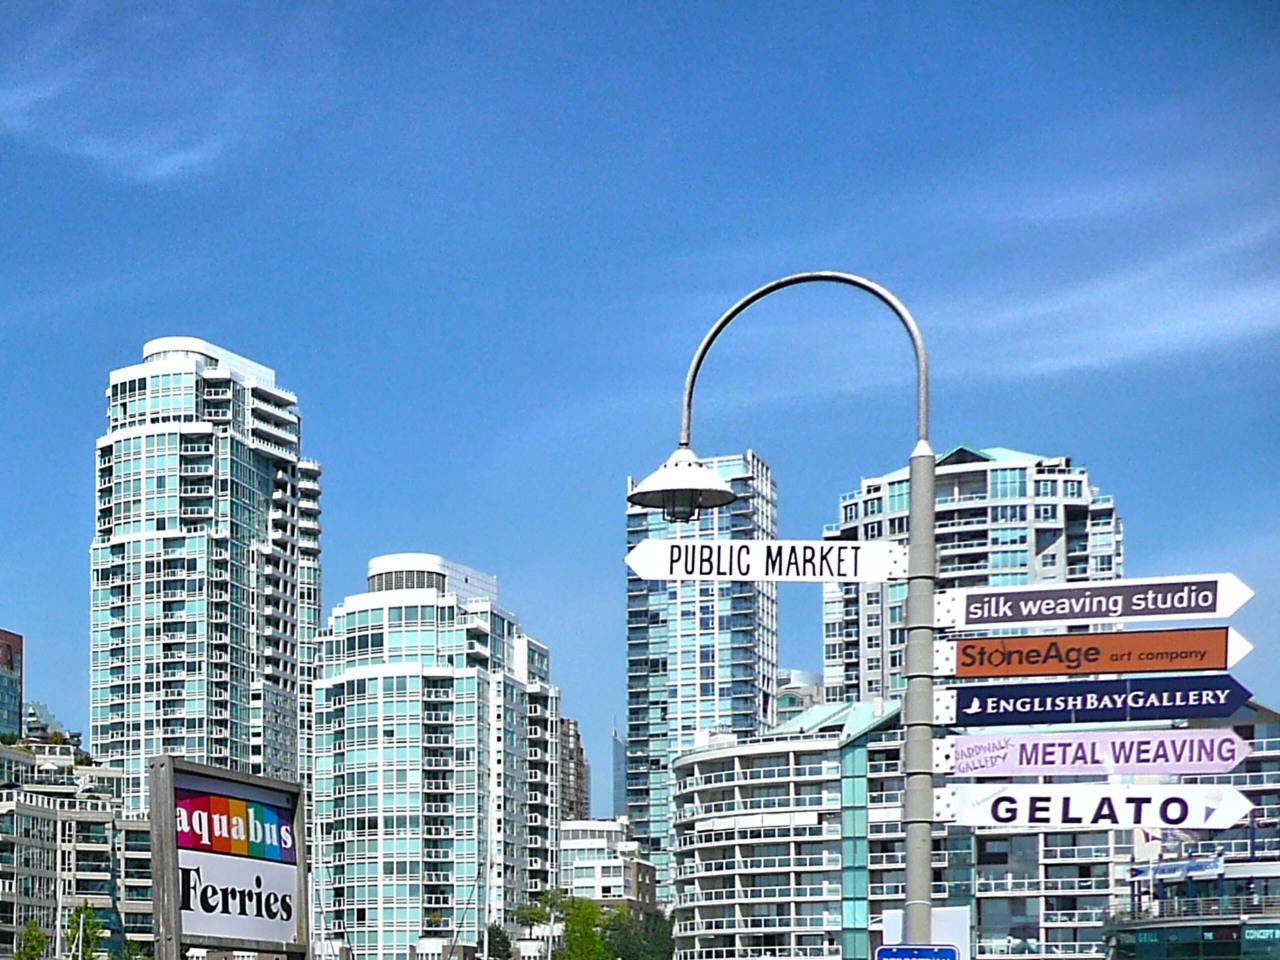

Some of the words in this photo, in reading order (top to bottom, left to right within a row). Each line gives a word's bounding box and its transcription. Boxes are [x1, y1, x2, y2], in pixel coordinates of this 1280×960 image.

[669, 544, 751, 576] PUBLIC
[765, 545, 861, 578] MARKET
[968, 596, 1013, 619] silk
[1020, 591, 1124, 617] weaving
[1131, 587, 1214, 610] studio
[960, 641, 1101, 669] StoneAge
[1110, 651, 1133, 662] art
[1137, 648, 1208, 663] company
[1018, 742, 1104, 766] METAL
[1110, 737, 1236, 765] WEAVING
[990, 795, 1189, 825] GELATO
[176, 807, 293, 849] aquabus
[178, 866, 293, 922] Ferries
